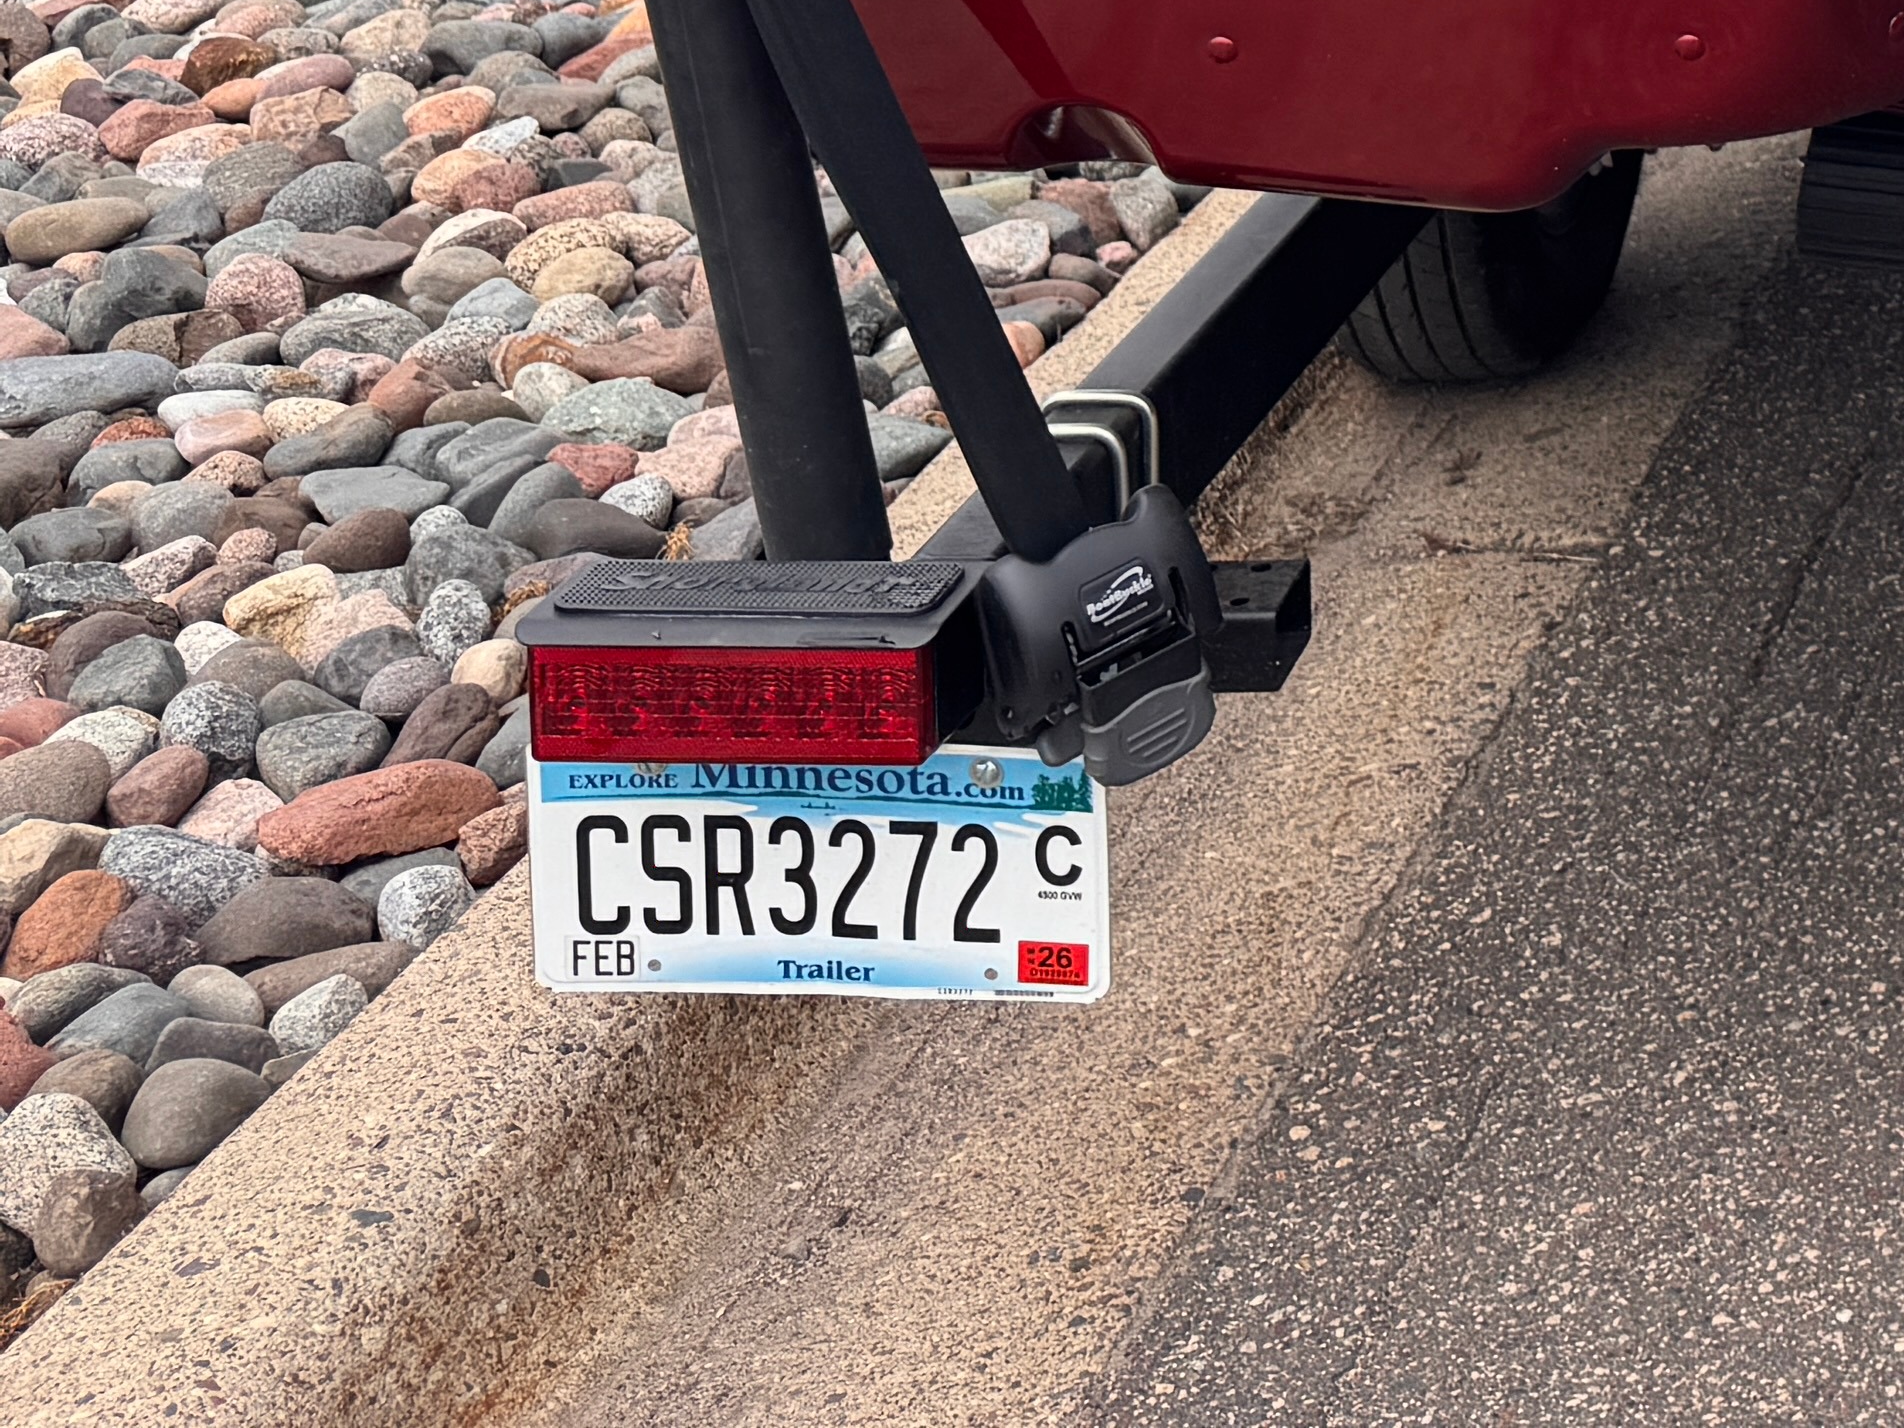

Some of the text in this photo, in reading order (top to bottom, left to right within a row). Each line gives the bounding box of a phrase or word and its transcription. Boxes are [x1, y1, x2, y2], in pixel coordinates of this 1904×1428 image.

[568, 772, 677, 790] EXPLORE
[575, 813, 1082, 944] CSR3272 C
[572, 940, 636, 978] FEB
[1037, 946, 1072, 969] 26
[776, 958, 876, 983] Trailer
